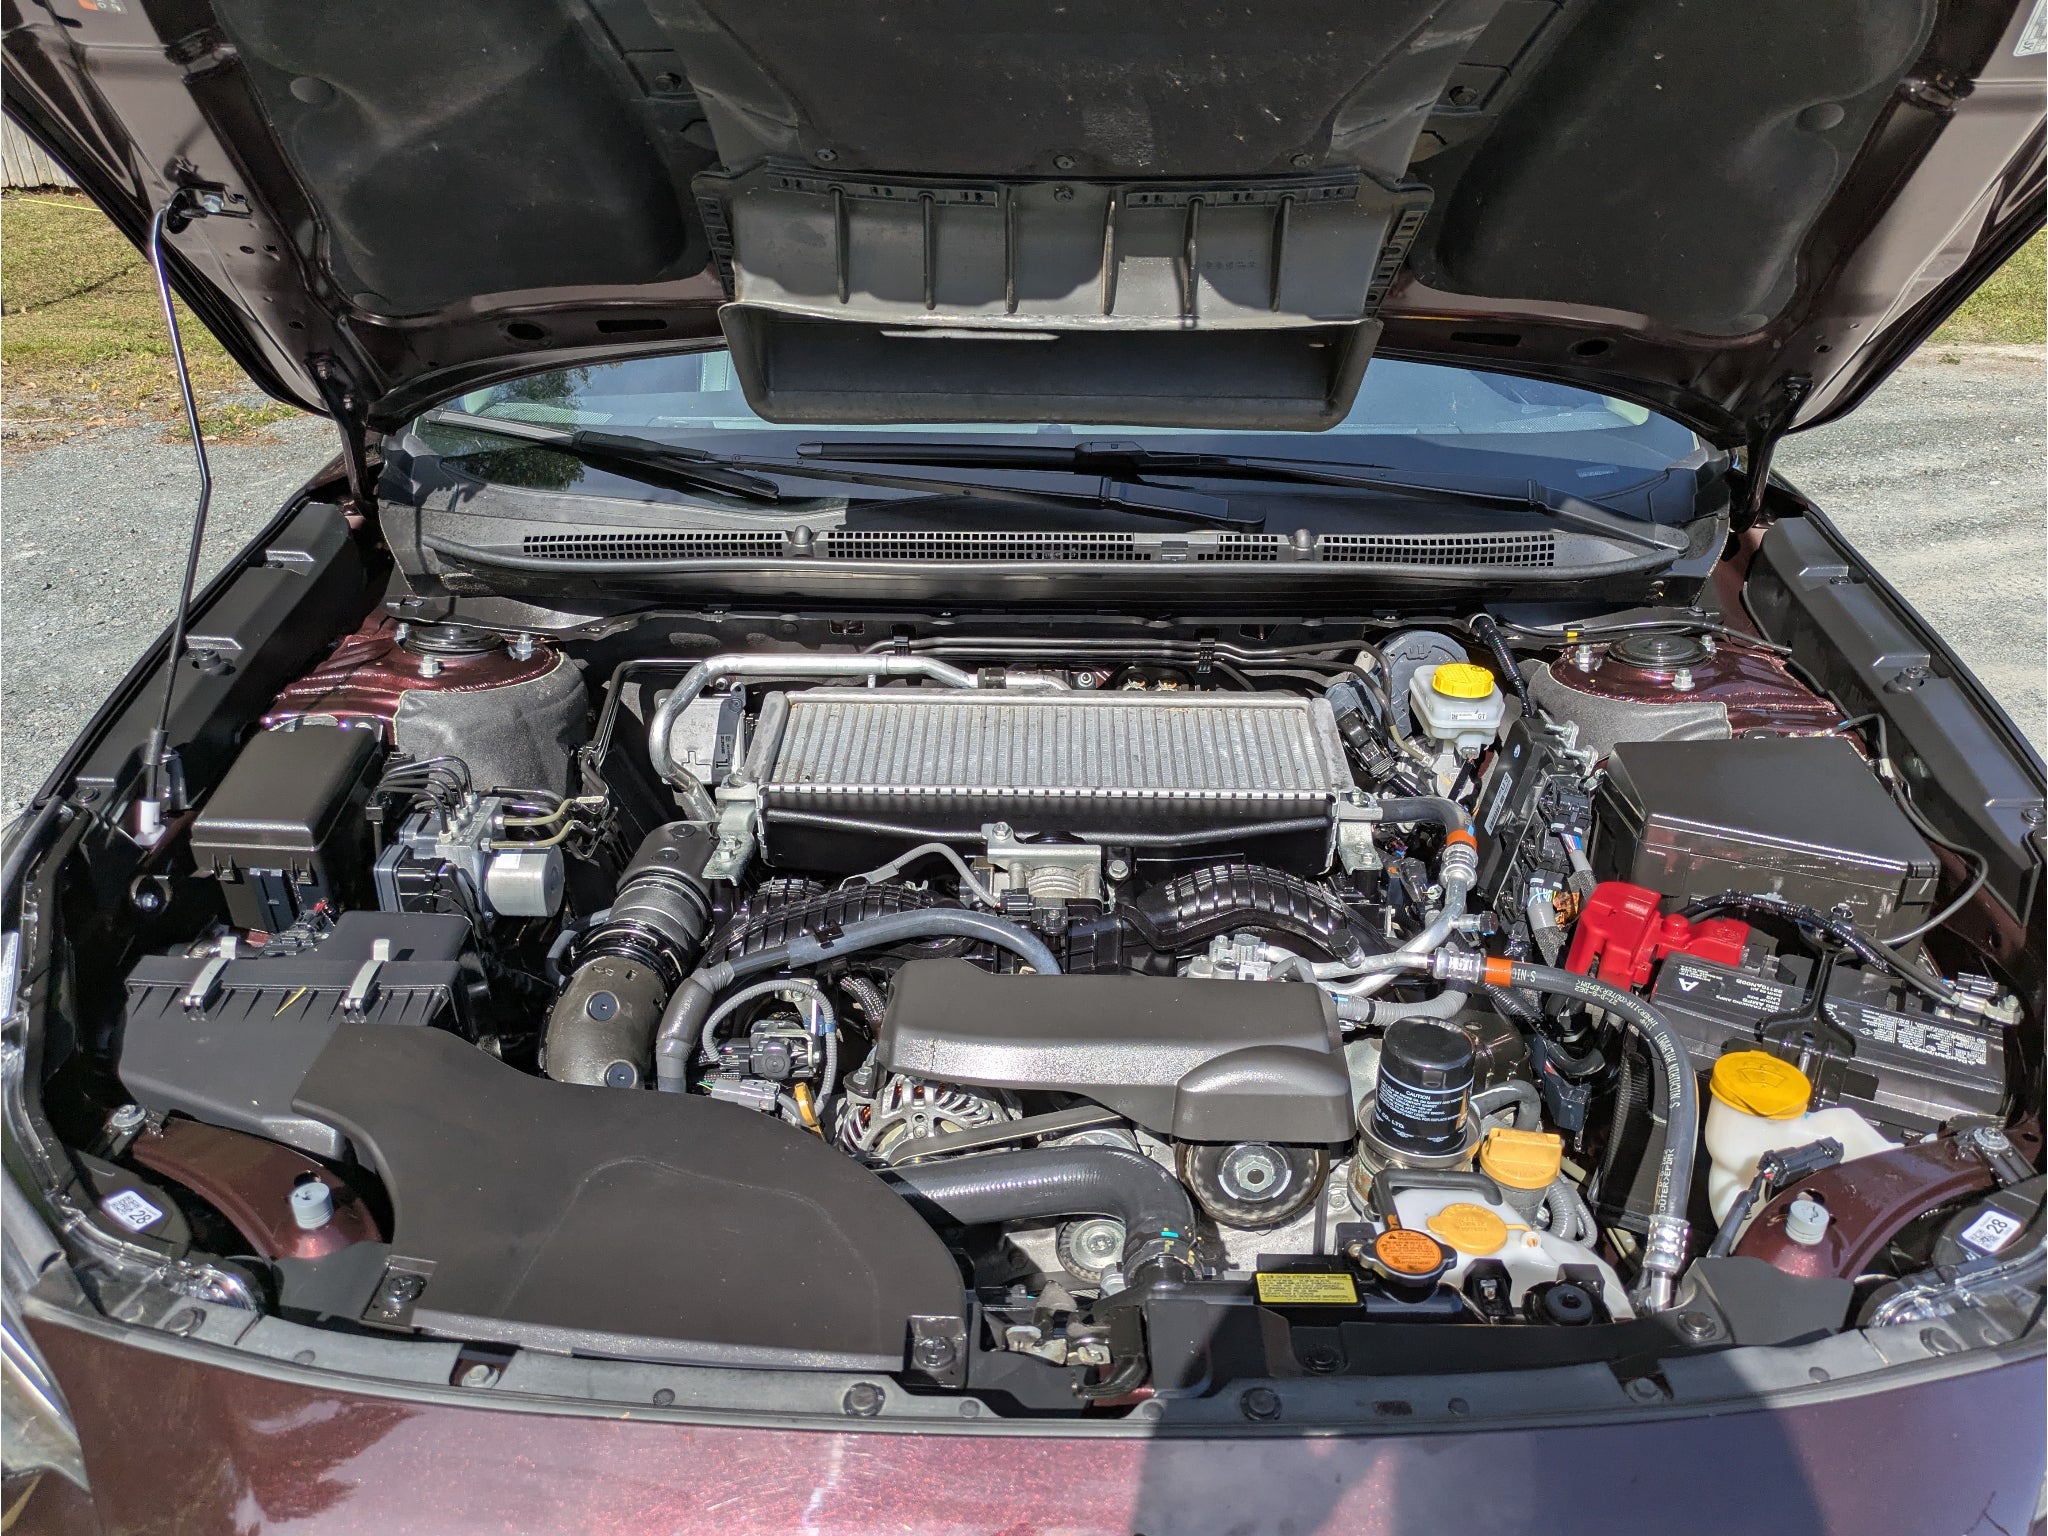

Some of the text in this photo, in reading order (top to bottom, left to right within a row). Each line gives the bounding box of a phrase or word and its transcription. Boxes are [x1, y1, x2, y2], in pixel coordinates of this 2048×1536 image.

[1405, 1091, 1431, 1101] CAUTION
[129, 1210, 153, 1225] 28
[1986, 1218, 2008, 1235] 28
